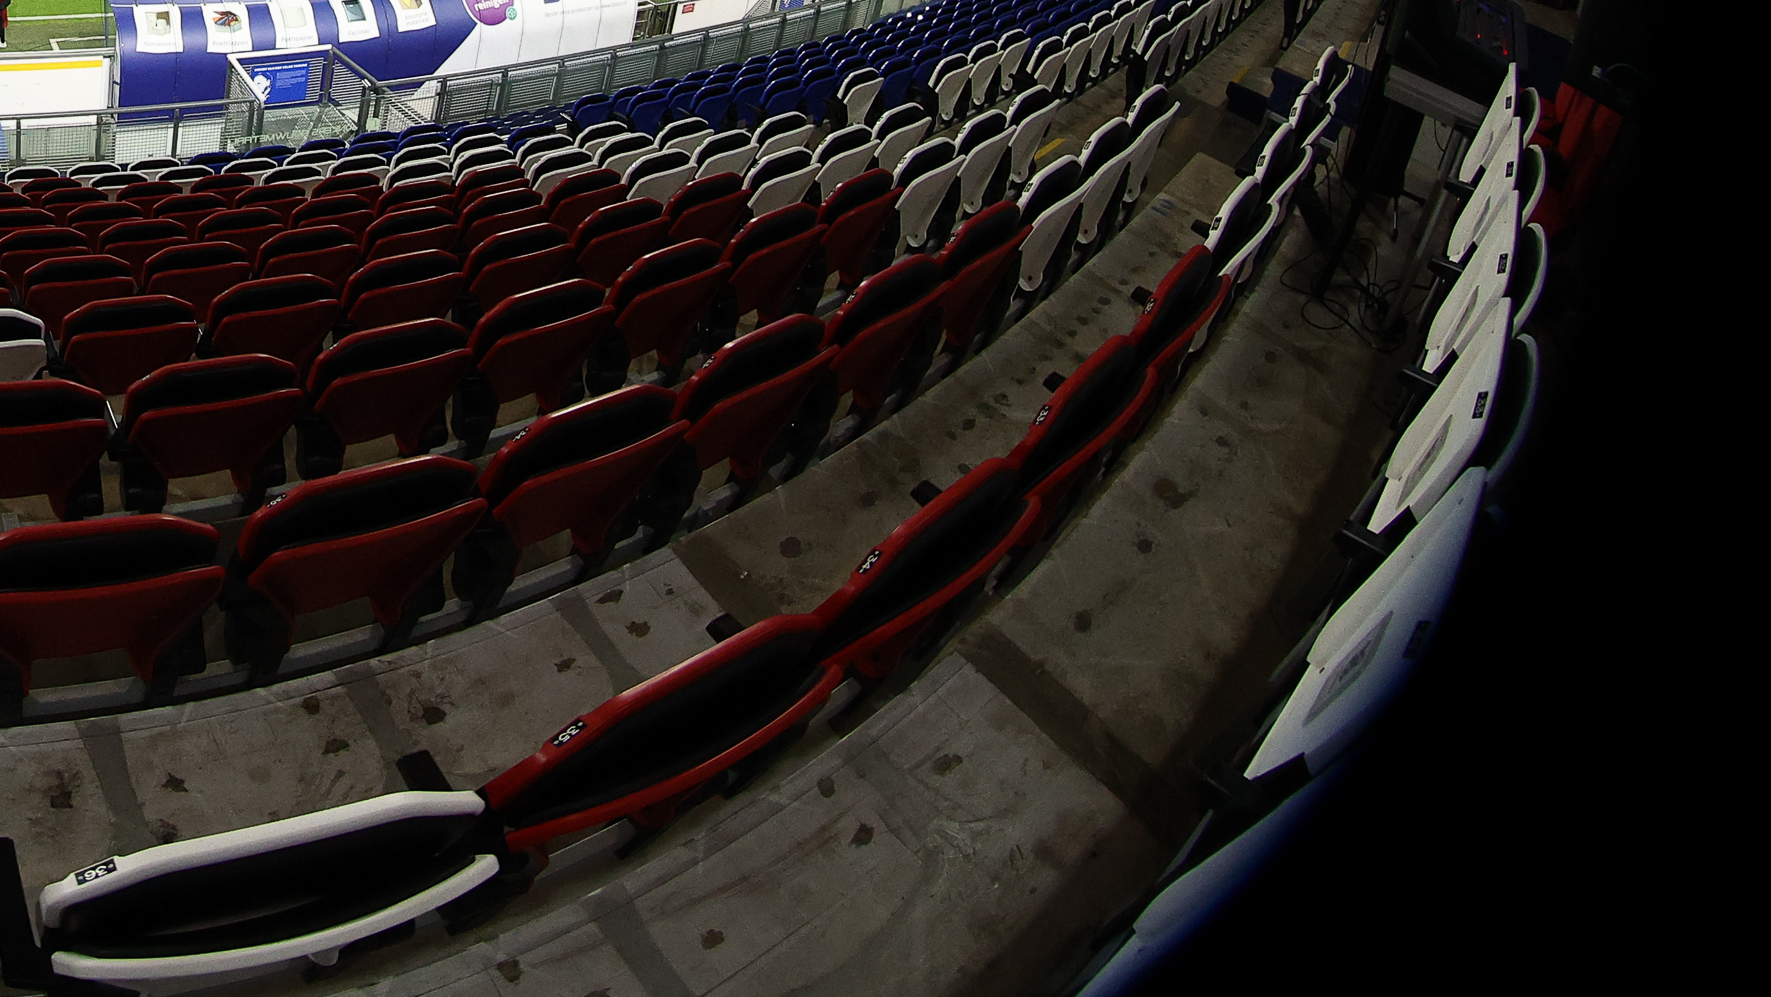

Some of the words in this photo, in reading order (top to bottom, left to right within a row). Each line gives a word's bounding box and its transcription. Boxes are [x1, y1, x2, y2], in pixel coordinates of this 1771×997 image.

[544, 10, 559, 18] Bestel
[281, 34, 314, 43] Poetspapier
[144, 40, 176, 48] Nonwoven
[212, 39, 248, 48] Poetslappen
[558, 726, 580, 743] 35
[84, 865, 108, 880] 36
